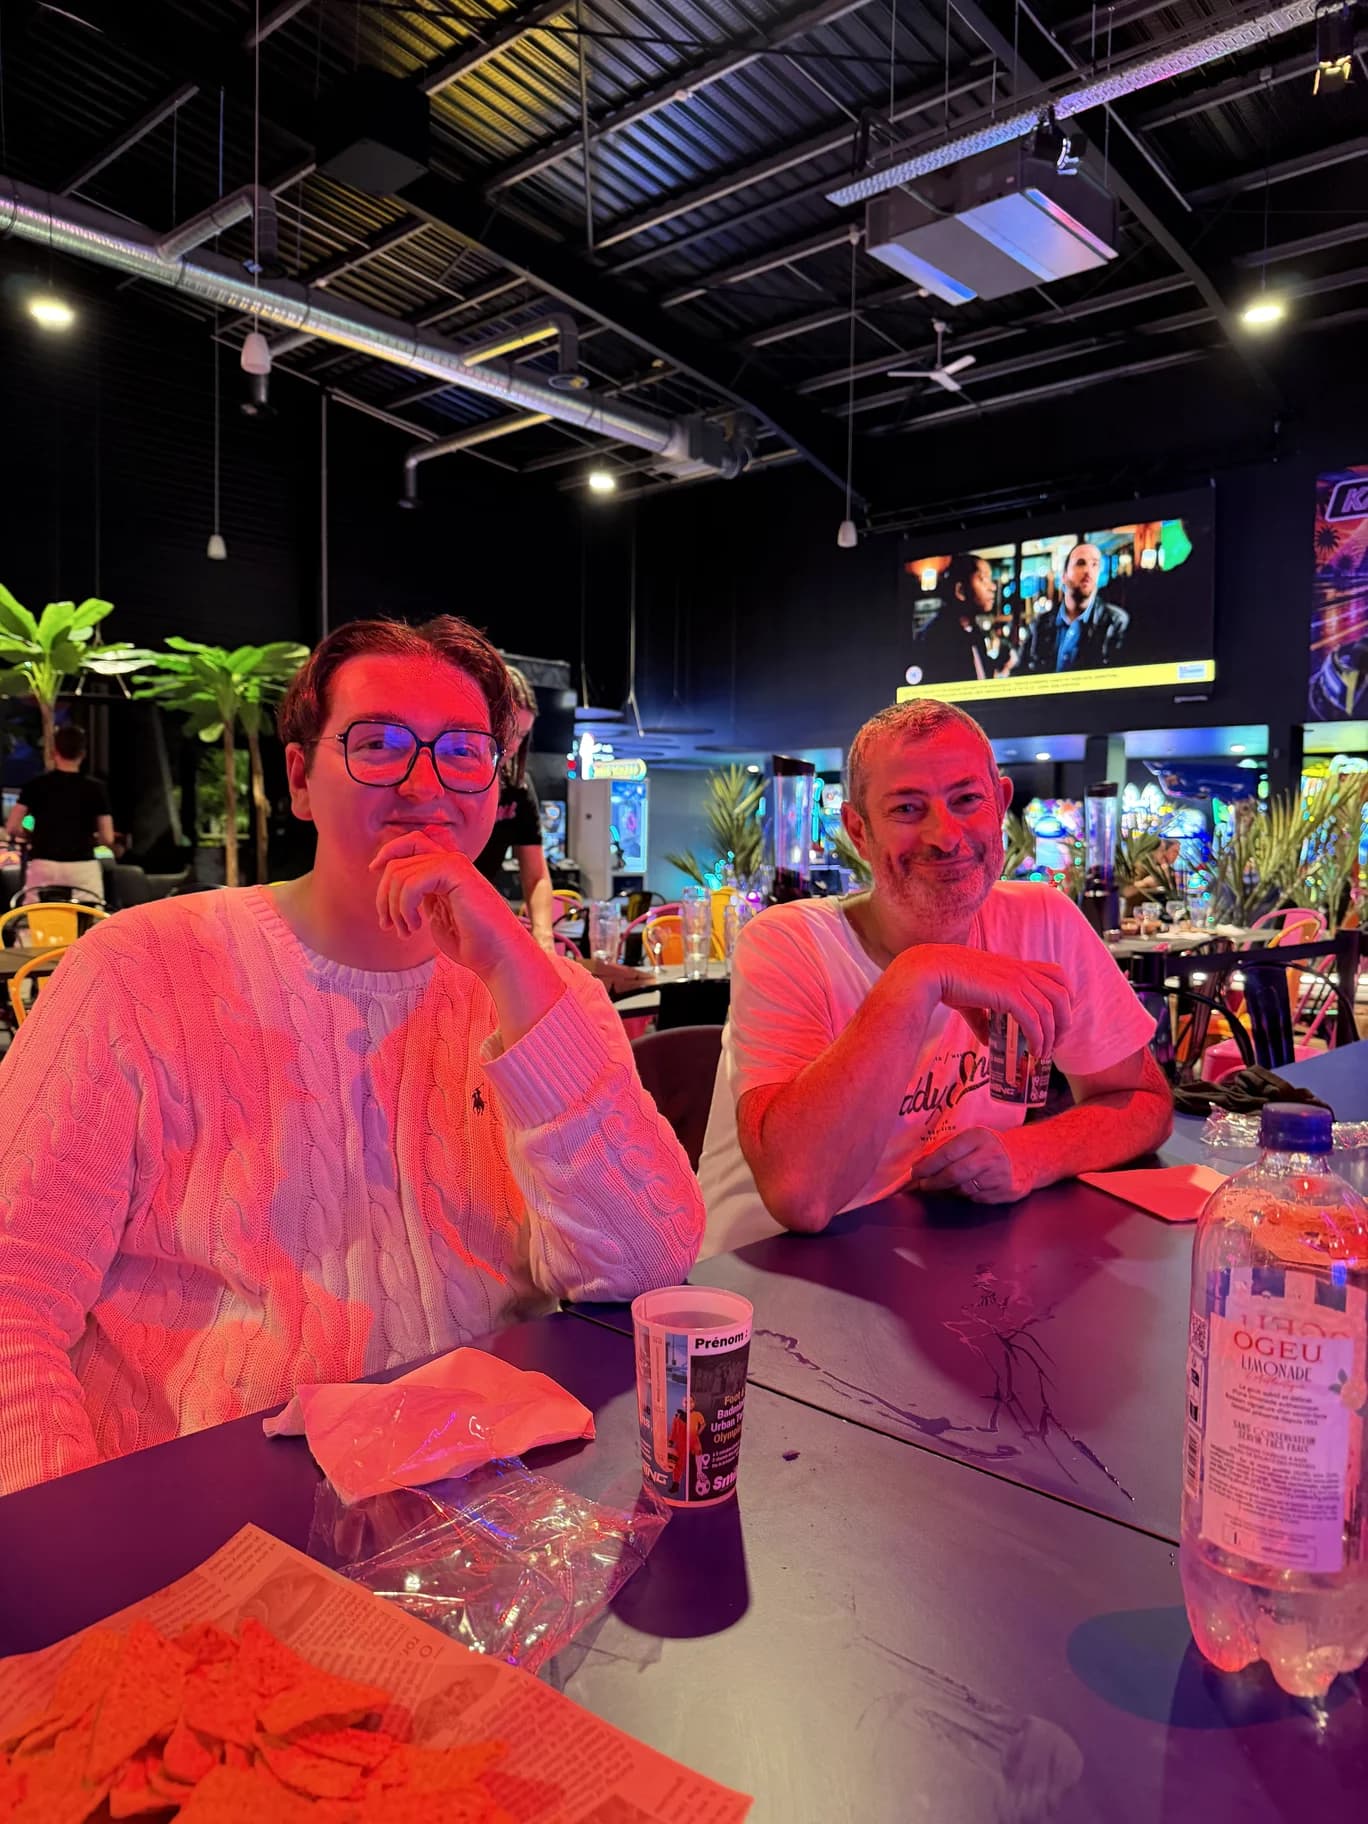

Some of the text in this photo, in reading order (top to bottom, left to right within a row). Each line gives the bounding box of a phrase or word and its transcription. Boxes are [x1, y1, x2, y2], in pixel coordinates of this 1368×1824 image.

[695, 1333, 744, 1349] Prénom
[1234, 1331, 1322, 1363] OGEU
[1241, 1354, 1312, 1382] LIMONADE
[711, 1418, 735, 1433] Urban
